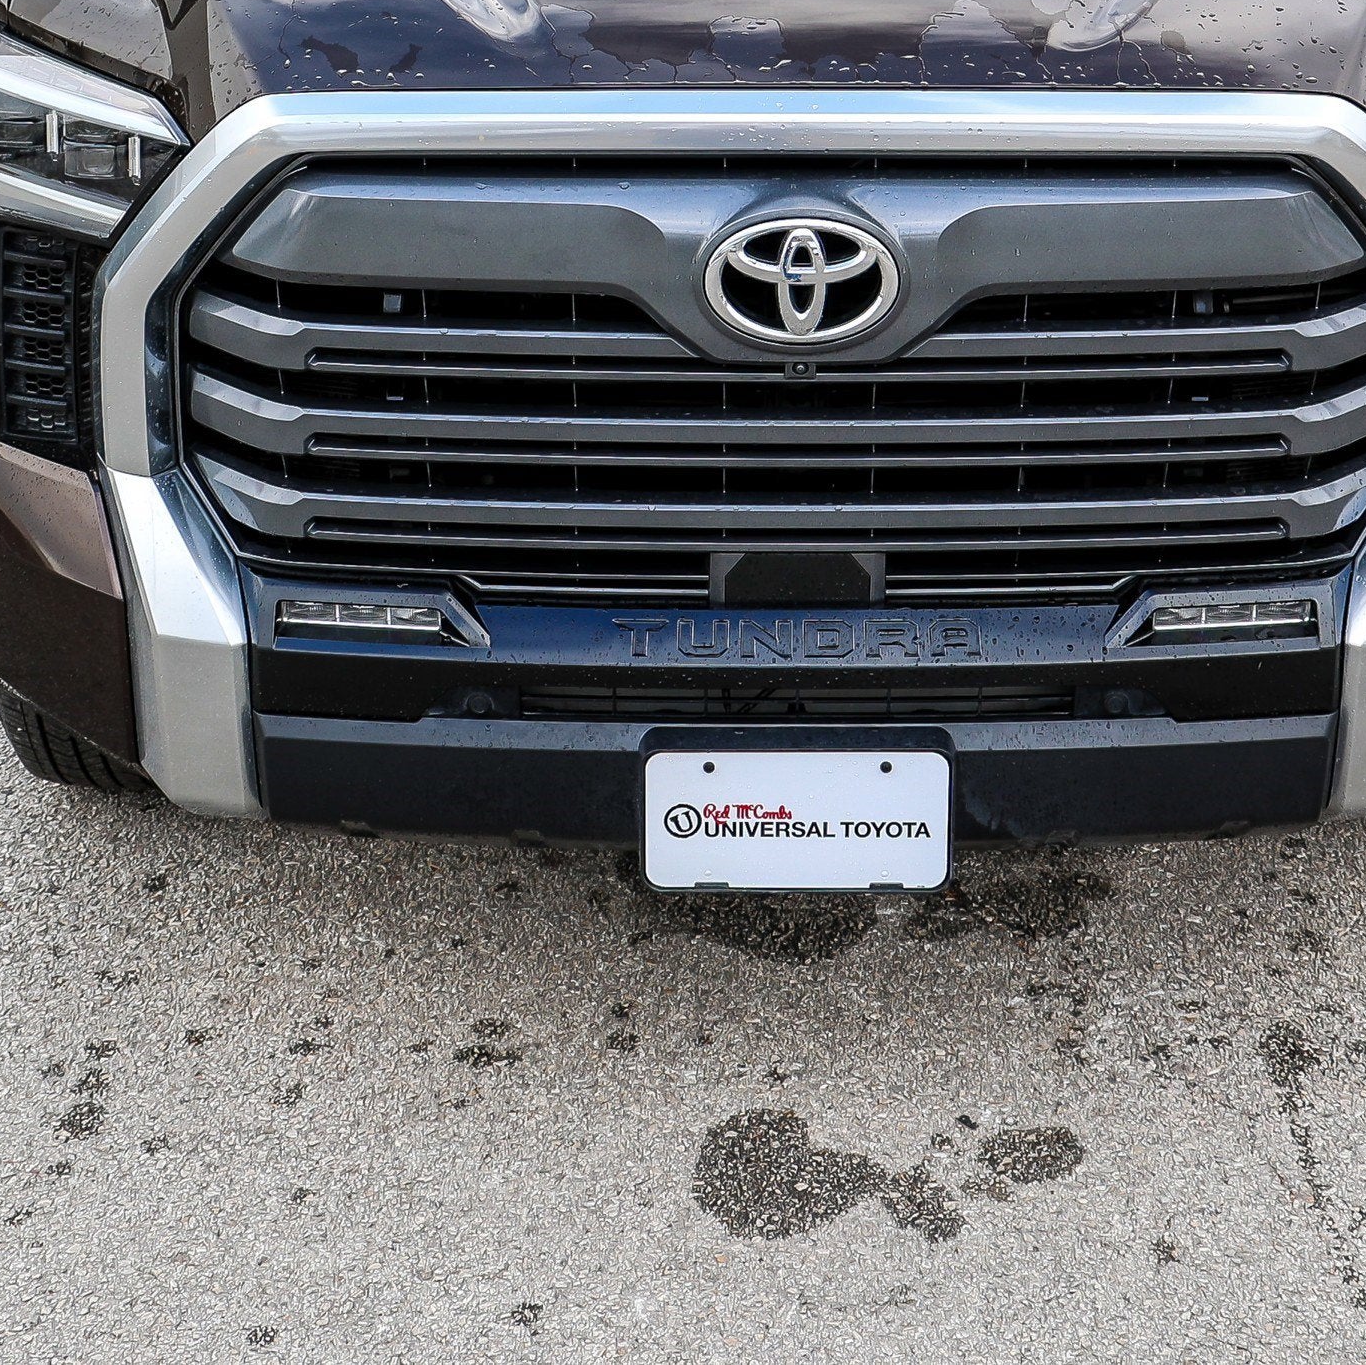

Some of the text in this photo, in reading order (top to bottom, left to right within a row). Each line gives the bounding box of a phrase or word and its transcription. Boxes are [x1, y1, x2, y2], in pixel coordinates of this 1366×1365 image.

[611, 617, 982, 659] TUNDRA
[703, 803, 793, 825] Red McCombs
[704, 821, 931, 838] UNIVERSAL TOYOTA
